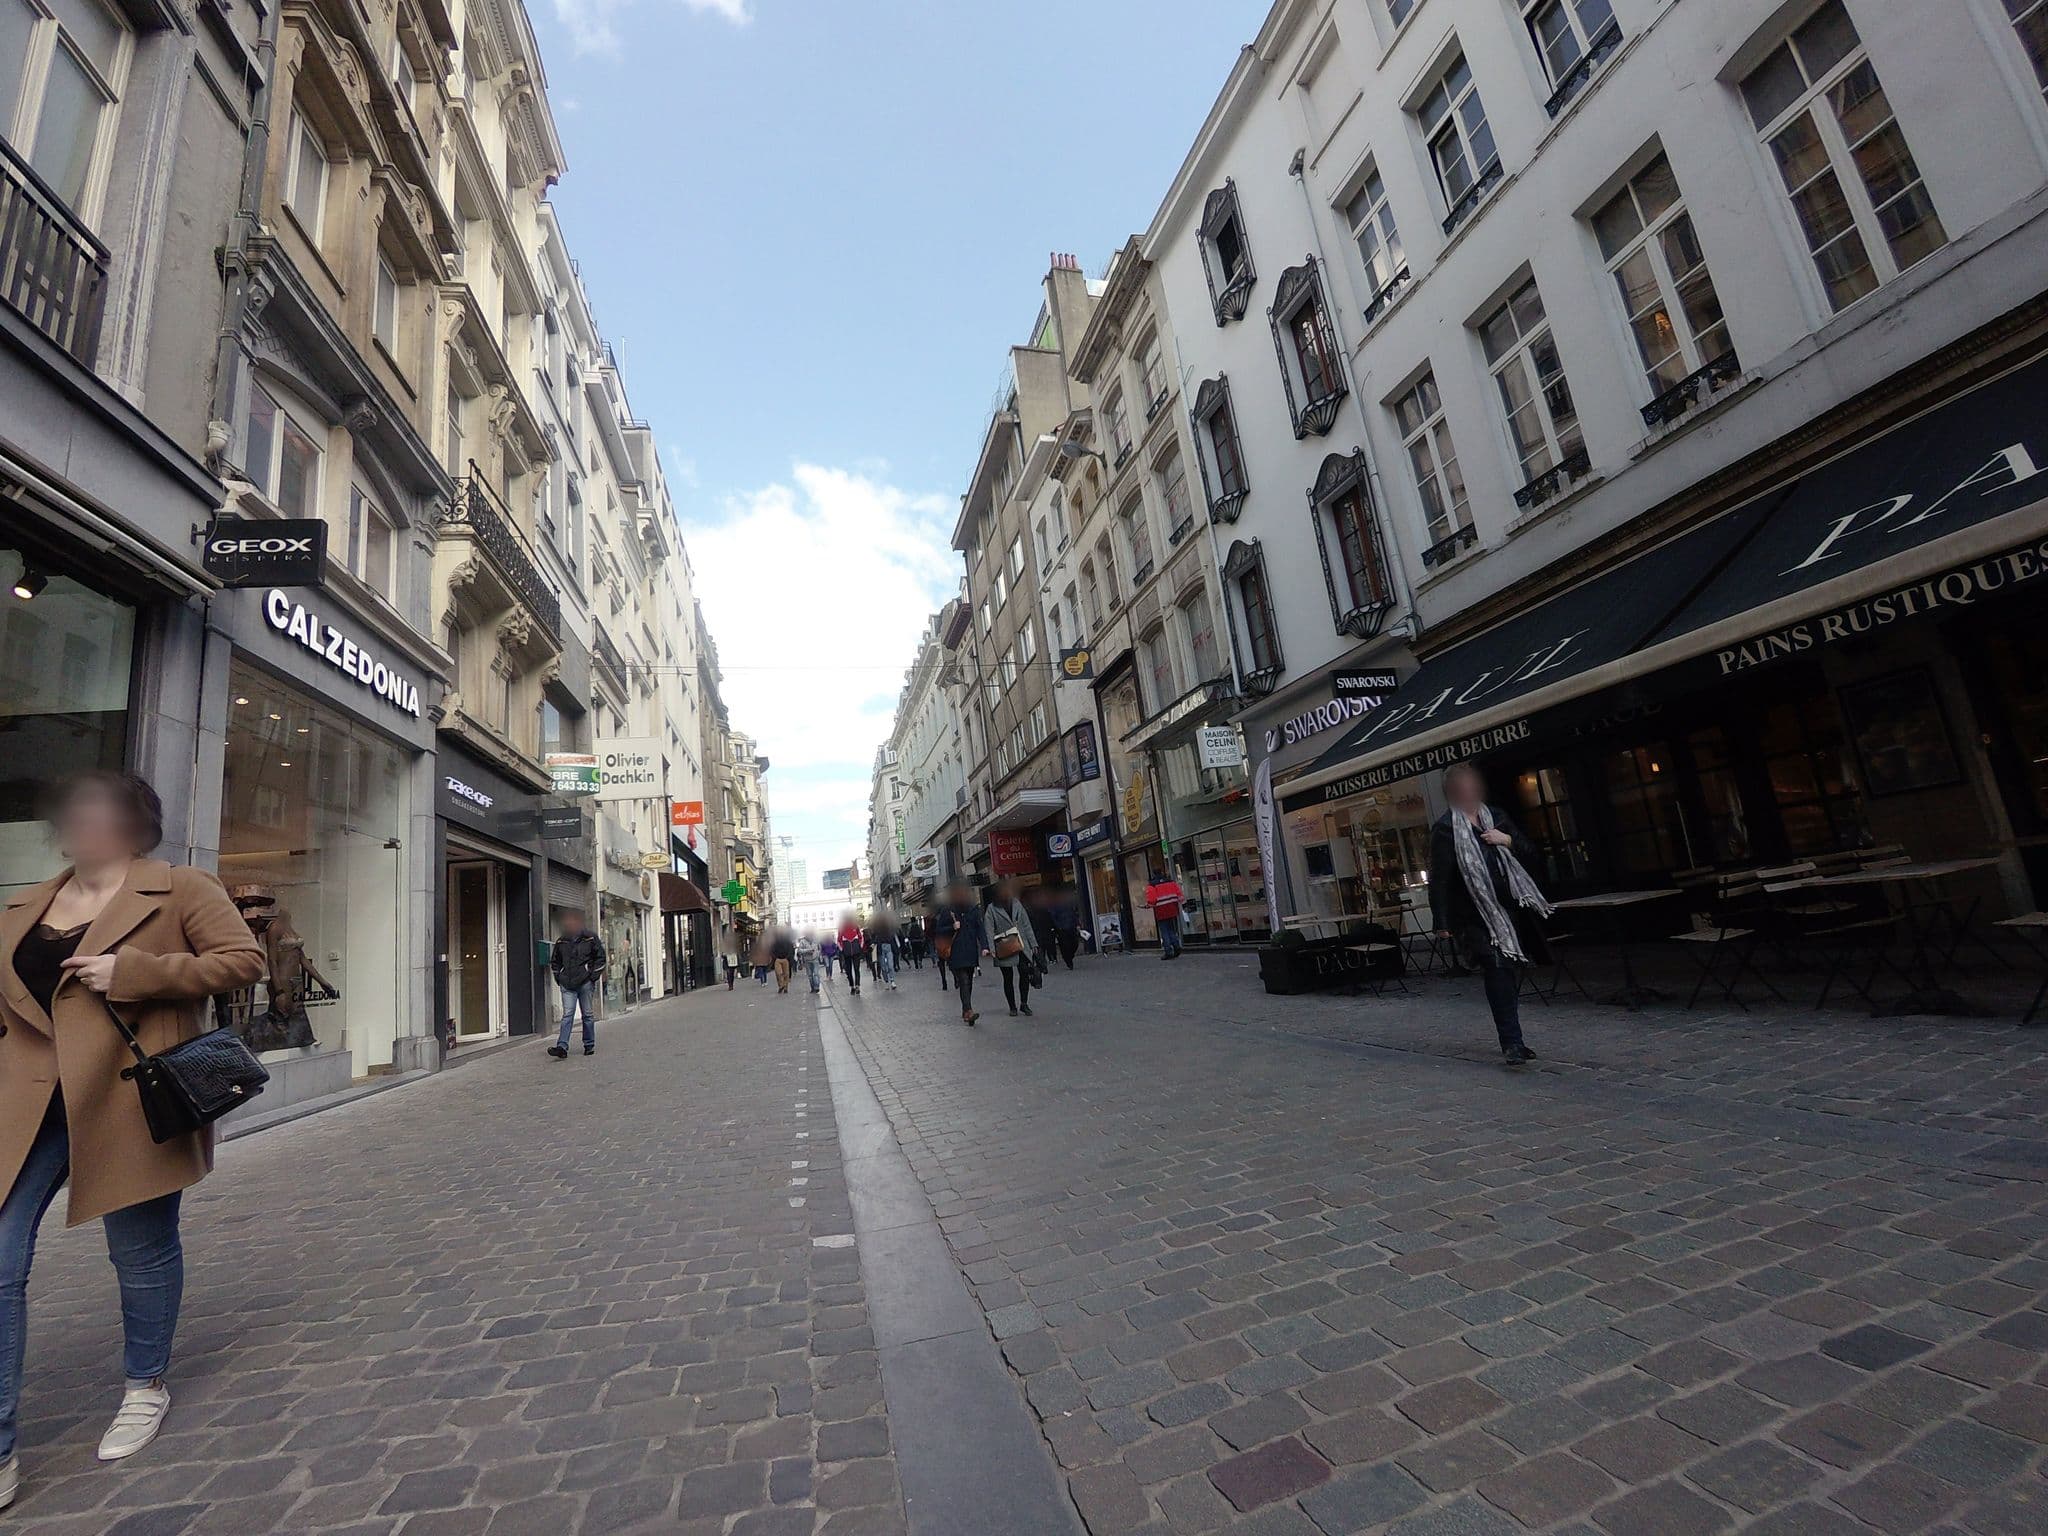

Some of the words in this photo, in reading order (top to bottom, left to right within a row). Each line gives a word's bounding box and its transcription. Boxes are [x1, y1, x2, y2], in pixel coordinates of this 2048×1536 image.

[210, 538, 313, 553] GEOX
[266, 589, 420, 718] CALZEDONIA
[1718, 624, 1813, 676] PAINS
[1336, 675, 1396, 689] SWAROVSKI
[1350, 628, 1590, 748] PAUL
[1204, 730, 1235, 738] MAISON
[1206, 738, 1237, 748] CELINI
[605, 752, 650, 768] Olivier
[1325, 766, 1391, 800] PATISSERIE
[1392, 755, 1424, 779] FINE
[1427, 746, 1459, 768] PUR
[1459, 719, 1531, 757] BEURRE
[551, 772, 579, 780] BRE
[601, 769, 655, 785] Dachkin
[557, 781, 575, 791] 643
[576, 782, 588, 791] 33
[589, 783, 600, 793] 33
[674, 807, 701, 820] ethias
[997, 834, 1032, 845] Galerie
[1000, 851, 1031, 860] Centre
